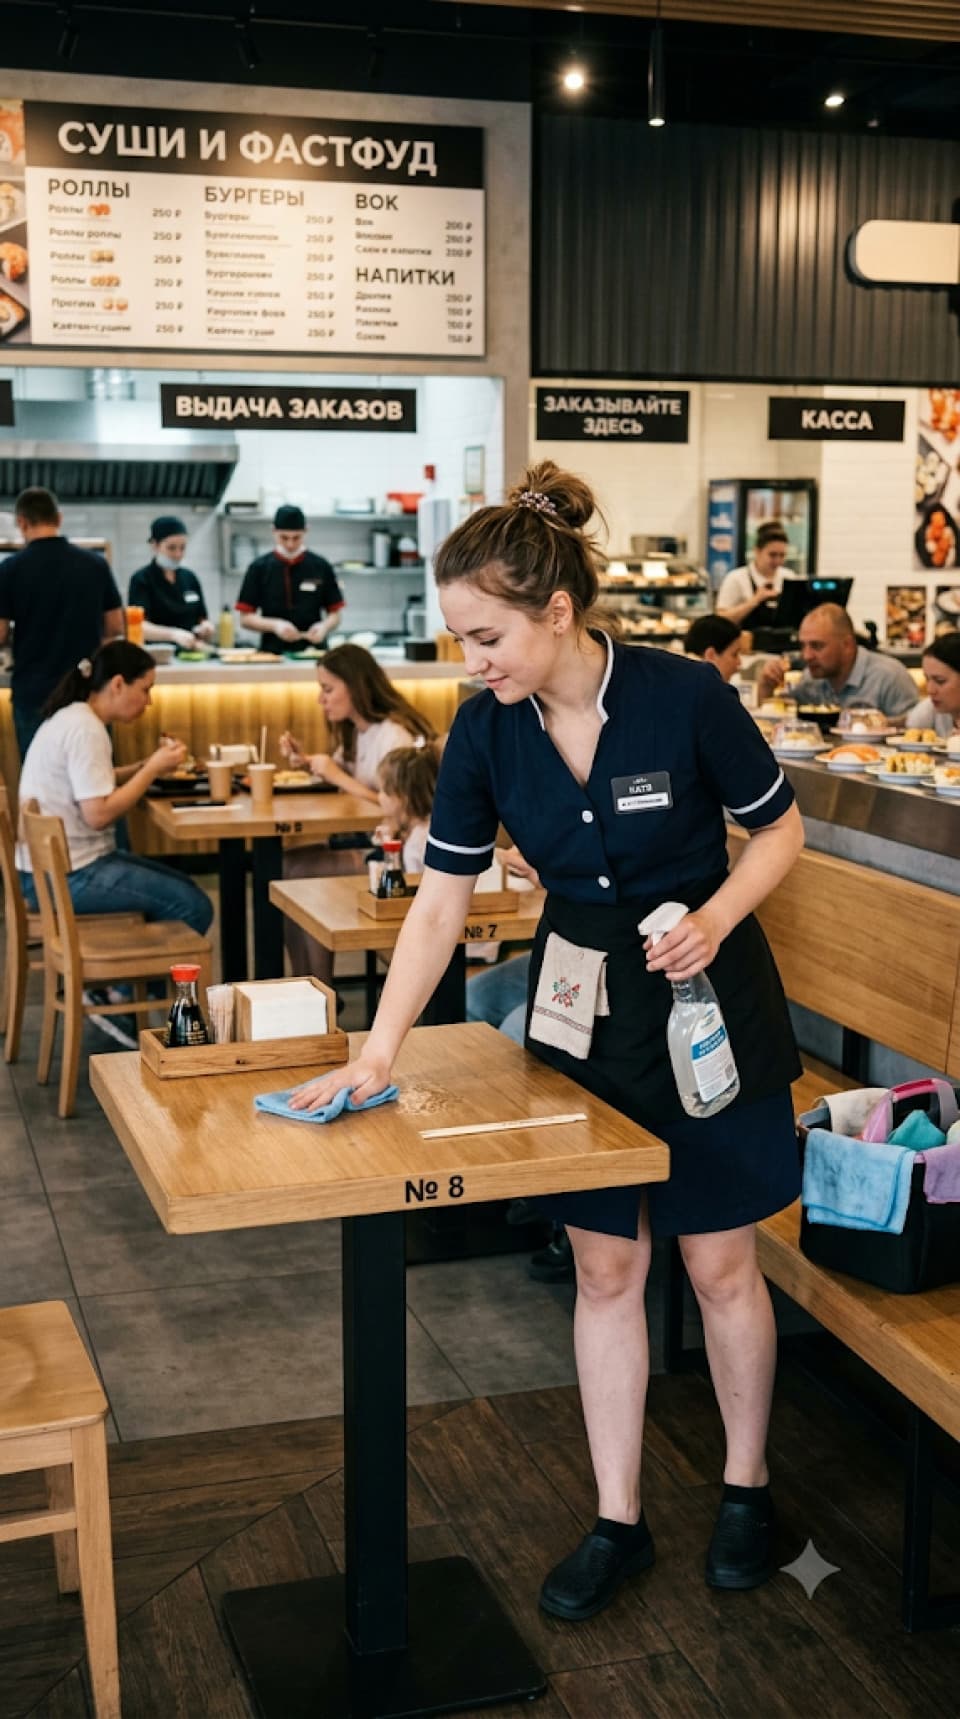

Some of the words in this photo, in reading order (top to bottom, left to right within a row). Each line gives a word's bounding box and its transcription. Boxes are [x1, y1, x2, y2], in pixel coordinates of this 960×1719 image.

[57, 121, 186, 159] СУШИ
[200, 129, 226, 161] И
[239, 130, 438, 177] ФАСТФУД
[48, 179, 130, 198] РОЛЛЫ
[204, 186, 305, 206] БУРГЕРЫ
[355, 194, 399, 210] ВОК
[152, 208, 172, 217] 250
[153, 232, 172, 241] 250
[356, 267, 455, 286] НАПИТКИ
[175, 395, 282, 422] ВЫДАЧА
[288, 398, 403, 422] ЗАКАЗОВ
[543, 395, 682, 416] ЗАКАЗЫВАЙТЕ
[583, 417, 644, 435] ЗДЕСЬ
[801, 409, 874, 431] КАССА
[465, 926, 483, 938] №
[488, 925, 497, 937] 7
[404, 1178, 438, 1203] №
[448, 1175, 465, 1199] 8
